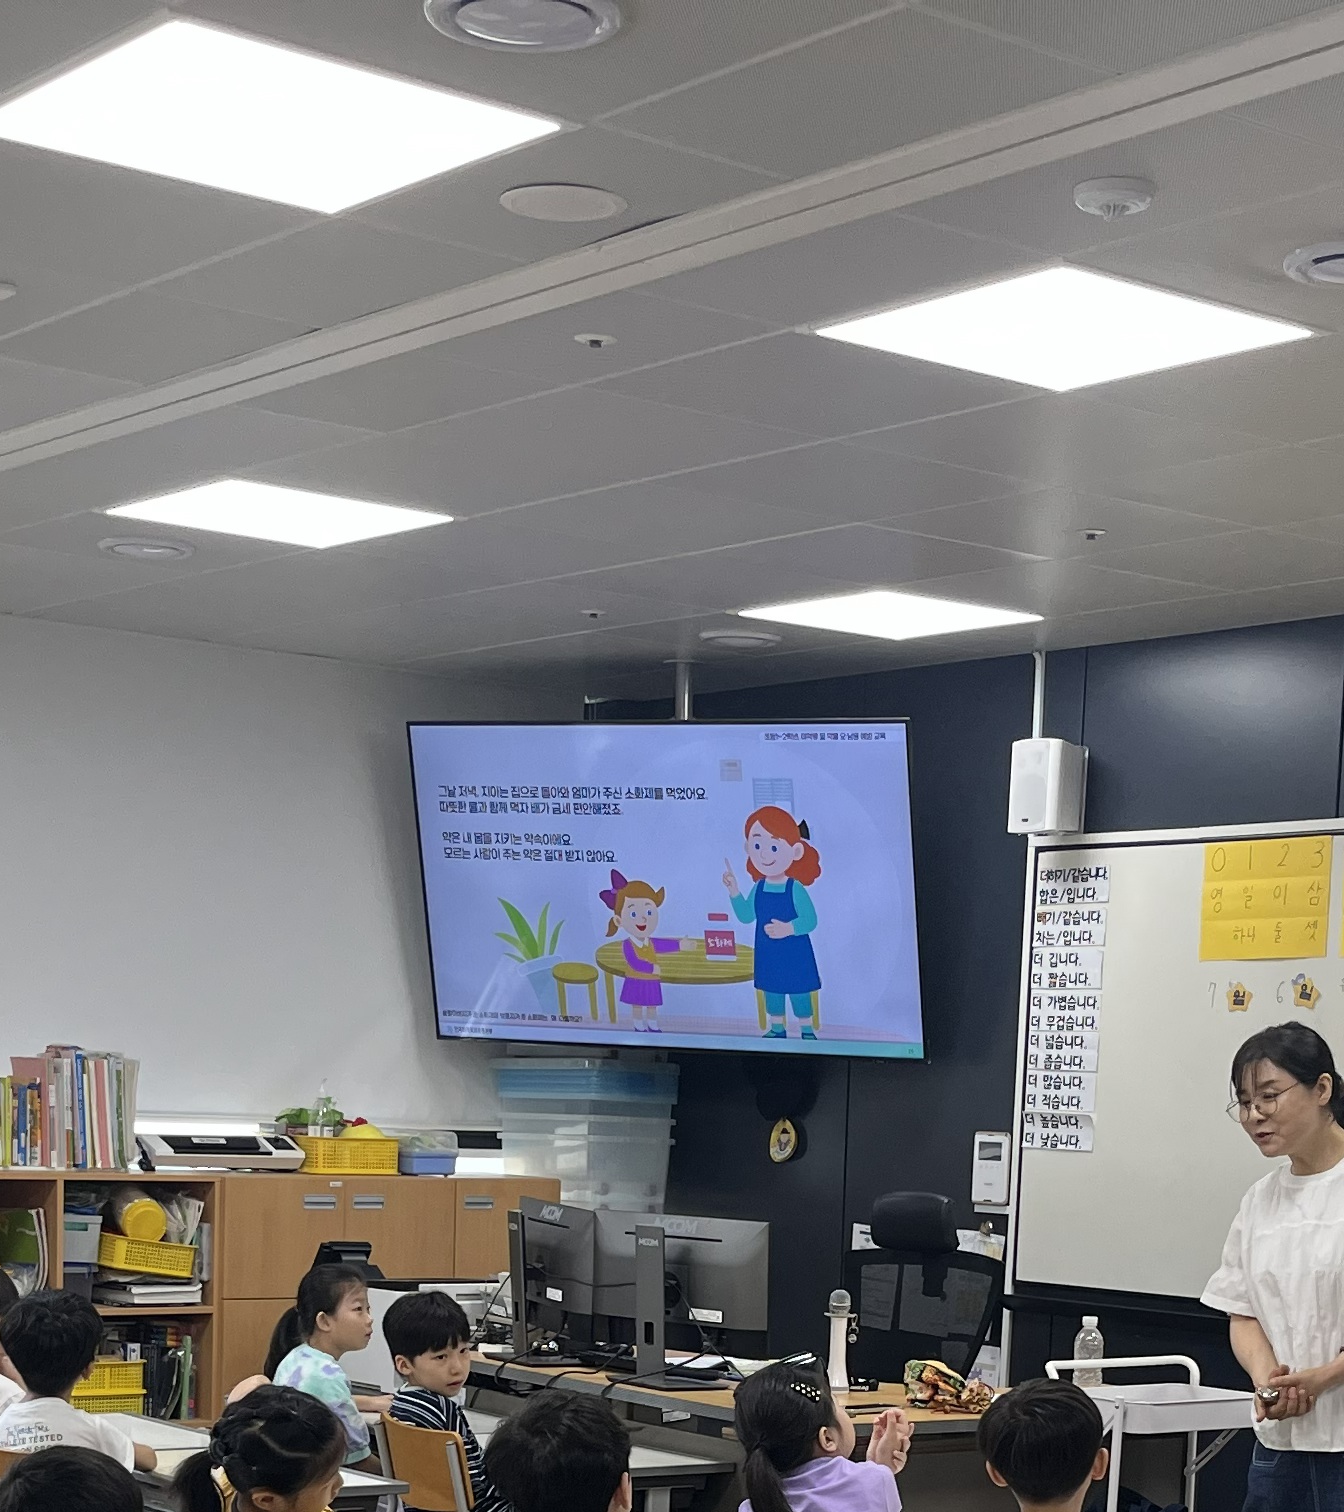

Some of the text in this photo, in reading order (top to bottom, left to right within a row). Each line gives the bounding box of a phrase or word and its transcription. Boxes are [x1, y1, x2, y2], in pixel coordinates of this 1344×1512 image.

[438, 785, 456, 798] 그날
[511, 786, 539, 799] 집으로
[603, 786, 622, 799] 주신
[625, 787, 663, 800] 소화제를
[442, 831, 460, 844] 약은
[462, 832, 472, 844] 내
[494, 833, 522, 845] 지키는
[444, 847, 471, 860] 모르는
[473, 848, 501, 860] 사람이
[502, 848, 522, 860] 주는
[523, 848, 542, 861] 약은
[564, 849, 584, 862] 받지
[1211, 841, 1325, 872] 0 1 2 3
[1211, 881, 1323, 913] 영 일 이 삼
[1232, 920, 1318, 944] 하나 둘 셋
[1033, 953, 1043, 967] 더
[1032, 973, 1042, 987] 더
[1207, 982, 1217, 1008] 7
[1276, 980, 1285, 1003] 6
[1032, 995, 1042, 1010] 더
[1031, 1015, 1040, 1029] 더
[1030, 1034, 1039, 1048] 더
[1029, 1054, 1038, 1068] 더
[1028, 1074, 1037, 1088] 더
[1027, 1093, 1036, 1108] 더
[1025, 1113, 1035, 1126] 더
[1025, 1132, 1035, 1146] 더
